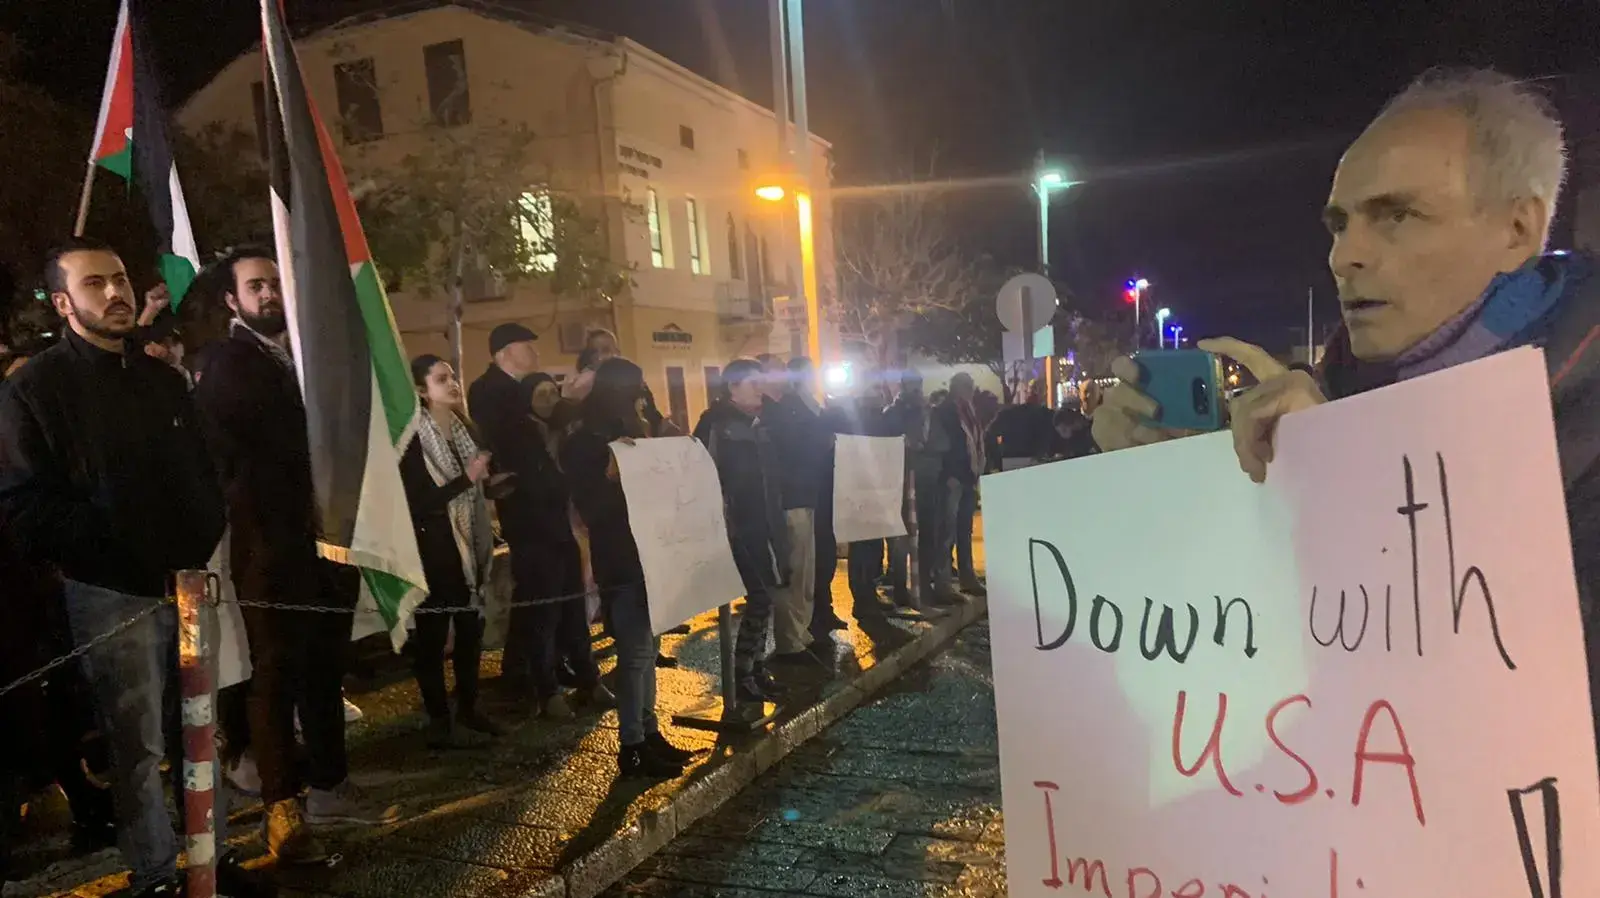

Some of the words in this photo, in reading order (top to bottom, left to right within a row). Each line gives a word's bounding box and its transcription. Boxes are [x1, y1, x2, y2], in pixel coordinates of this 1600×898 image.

[1028, 537, 1258, 664] Down
[1309, 451, 1517, 670] with
[1171, 690, 1426, 827] U.S.A
